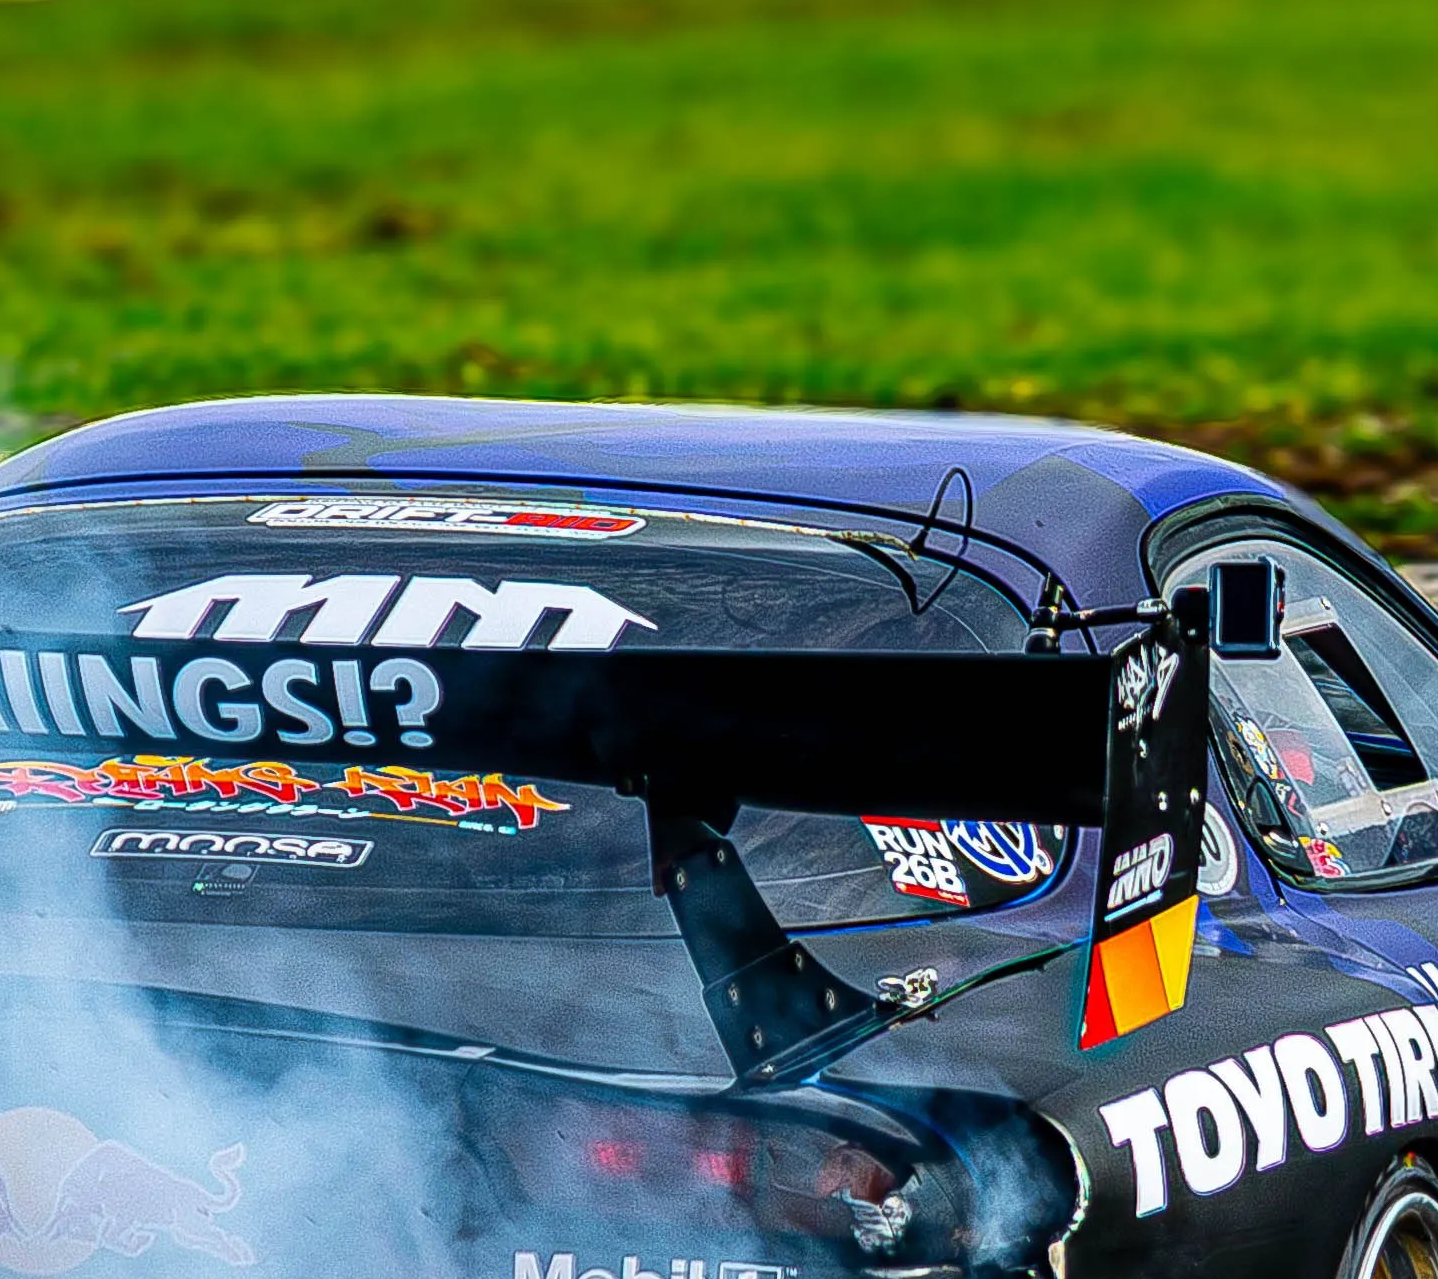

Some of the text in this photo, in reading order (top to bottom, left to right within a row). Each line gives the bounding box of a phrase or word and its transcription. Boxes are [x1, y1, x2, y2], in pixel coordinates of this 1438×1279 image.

[864, 823, 954, 861] RUN
[884, 850, 966, 894] 26B
[1099, 1033, 1349, 1218] TOYO
